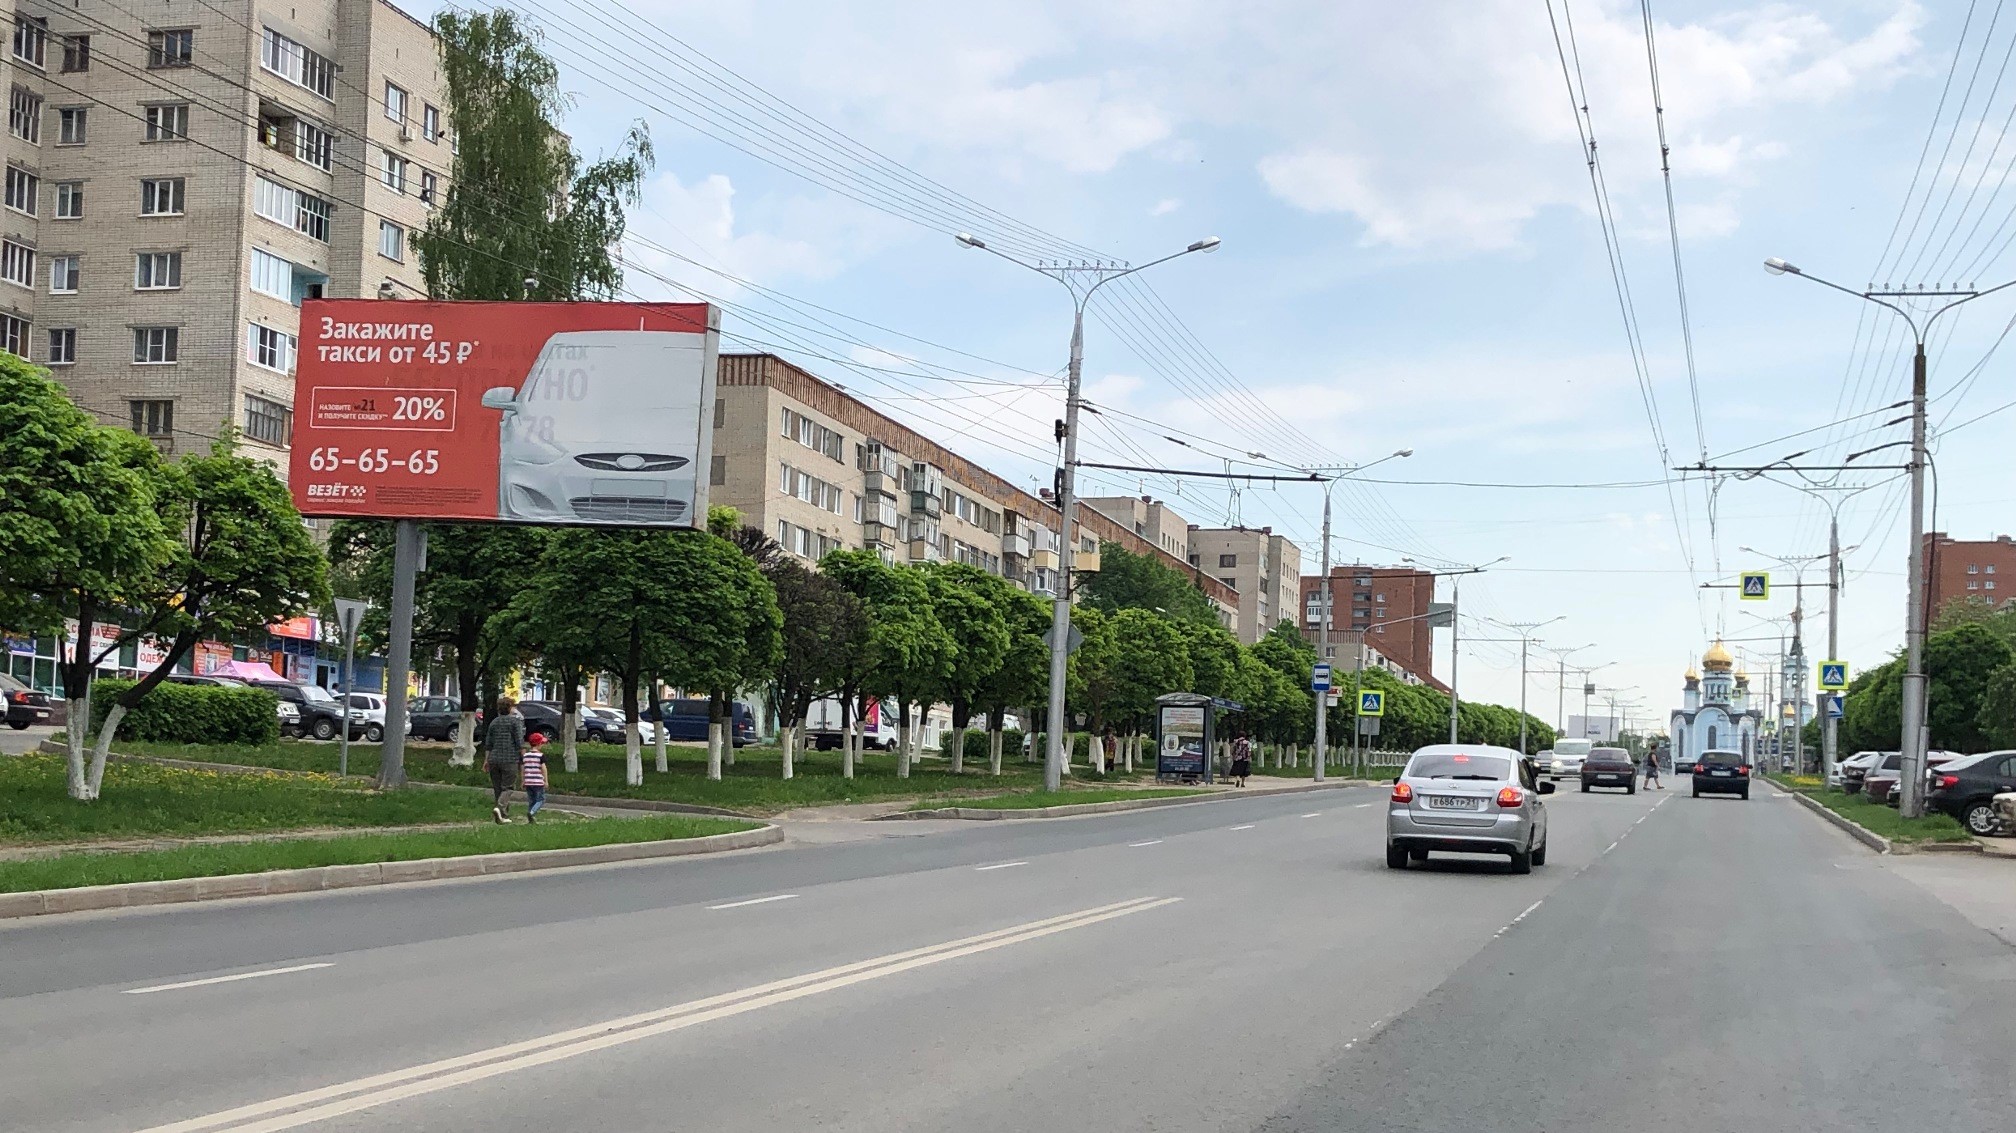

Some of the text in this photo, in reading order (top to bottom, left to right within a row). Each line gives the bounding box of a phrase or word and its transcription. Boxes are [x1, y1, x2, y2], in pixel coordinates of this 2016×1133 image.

[319, 316, 434, 341] Закажите
[317, 345, 381, 362] такси
[389, 346, 416, 363] от
[422, 341, 451, 364] 45
[392, 396, 446, 421] 20%
[307, 483, 349, 496] ВЕЗЁТ
